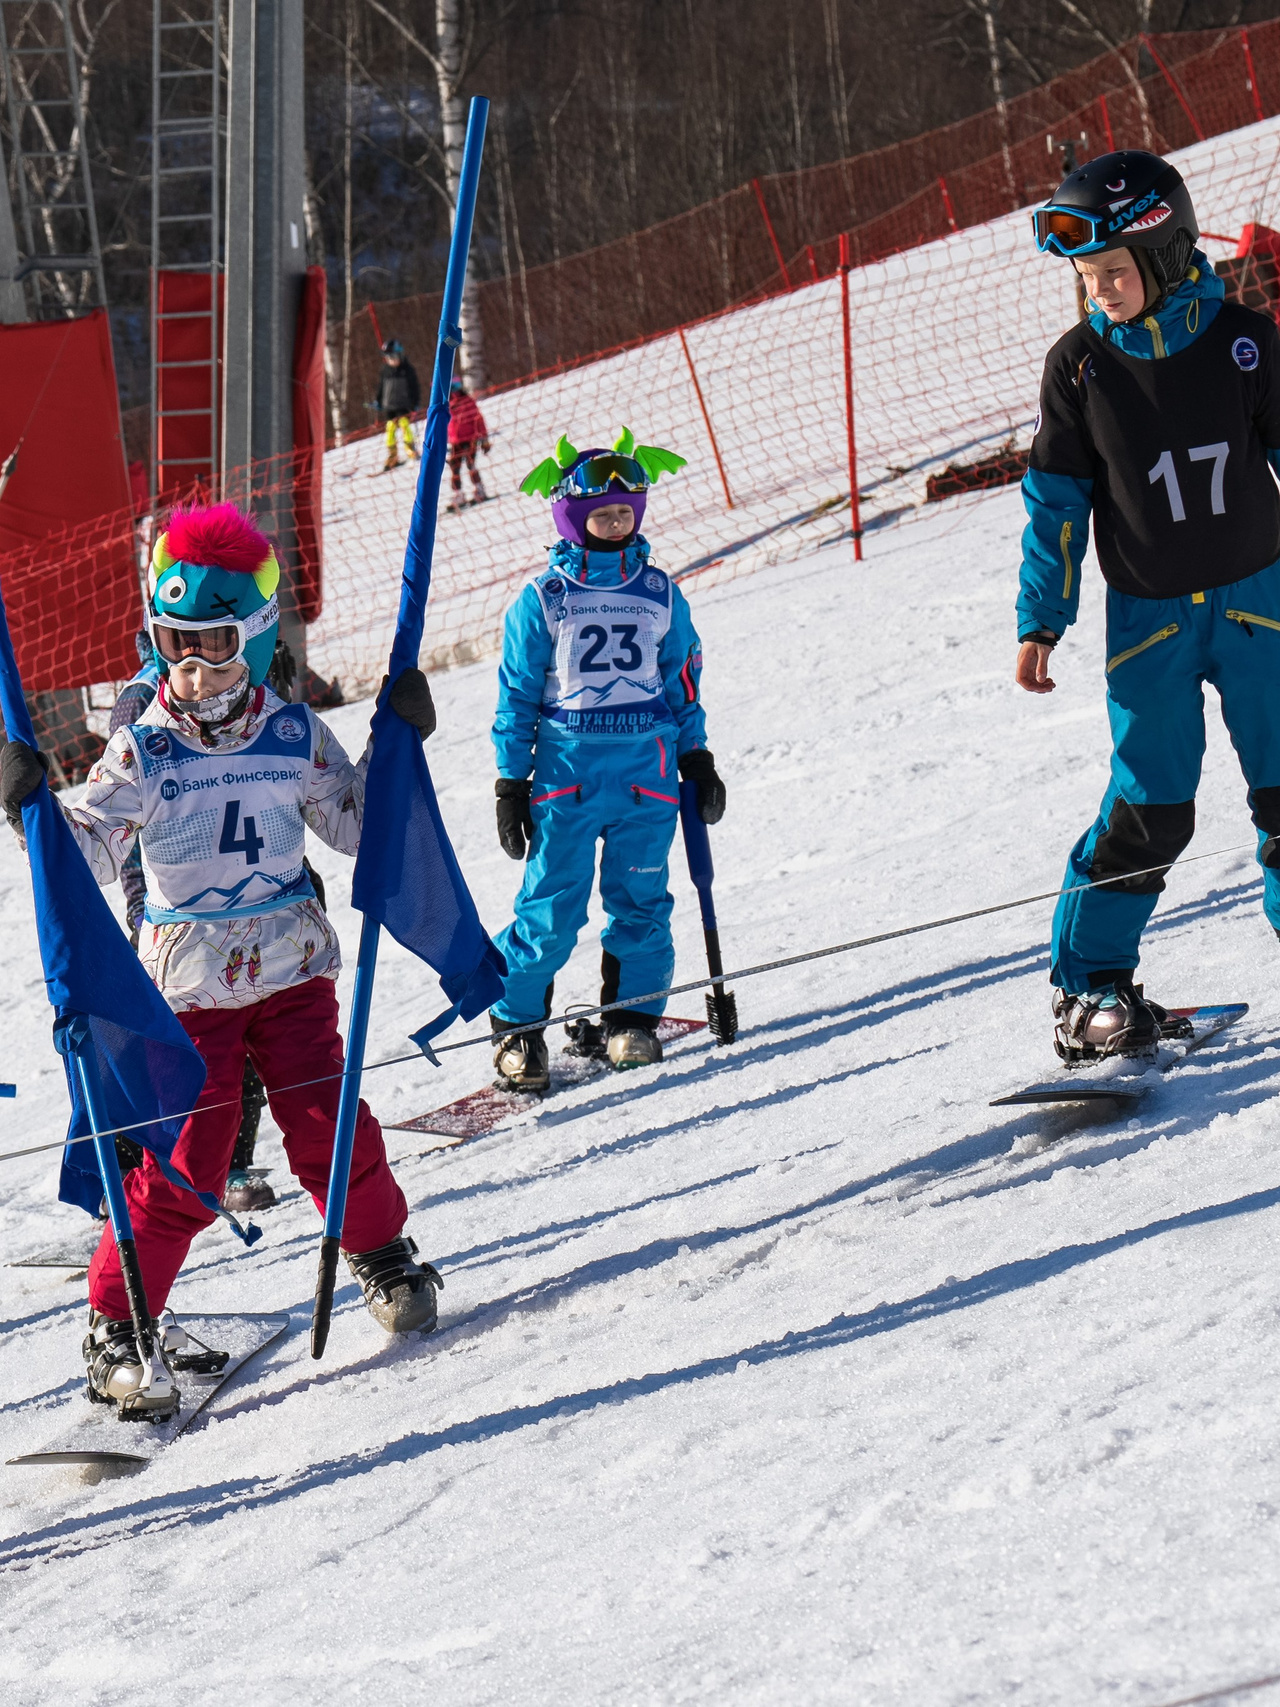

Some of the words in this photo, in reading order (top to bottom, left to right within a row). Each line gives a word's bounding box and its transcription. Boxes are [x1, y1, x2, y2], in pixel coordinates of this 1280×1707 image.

[1108, 189, 1160, 232] uvex
[1147, 441, 1230, 522] 17
[571, 604, 598, 615] Банк
[578, 624, 643, 673] 23
[182, 776, 220, 793] Банк
[222, 769, 303, 785] Финсервис
[219, 800, 265, 865] 4
